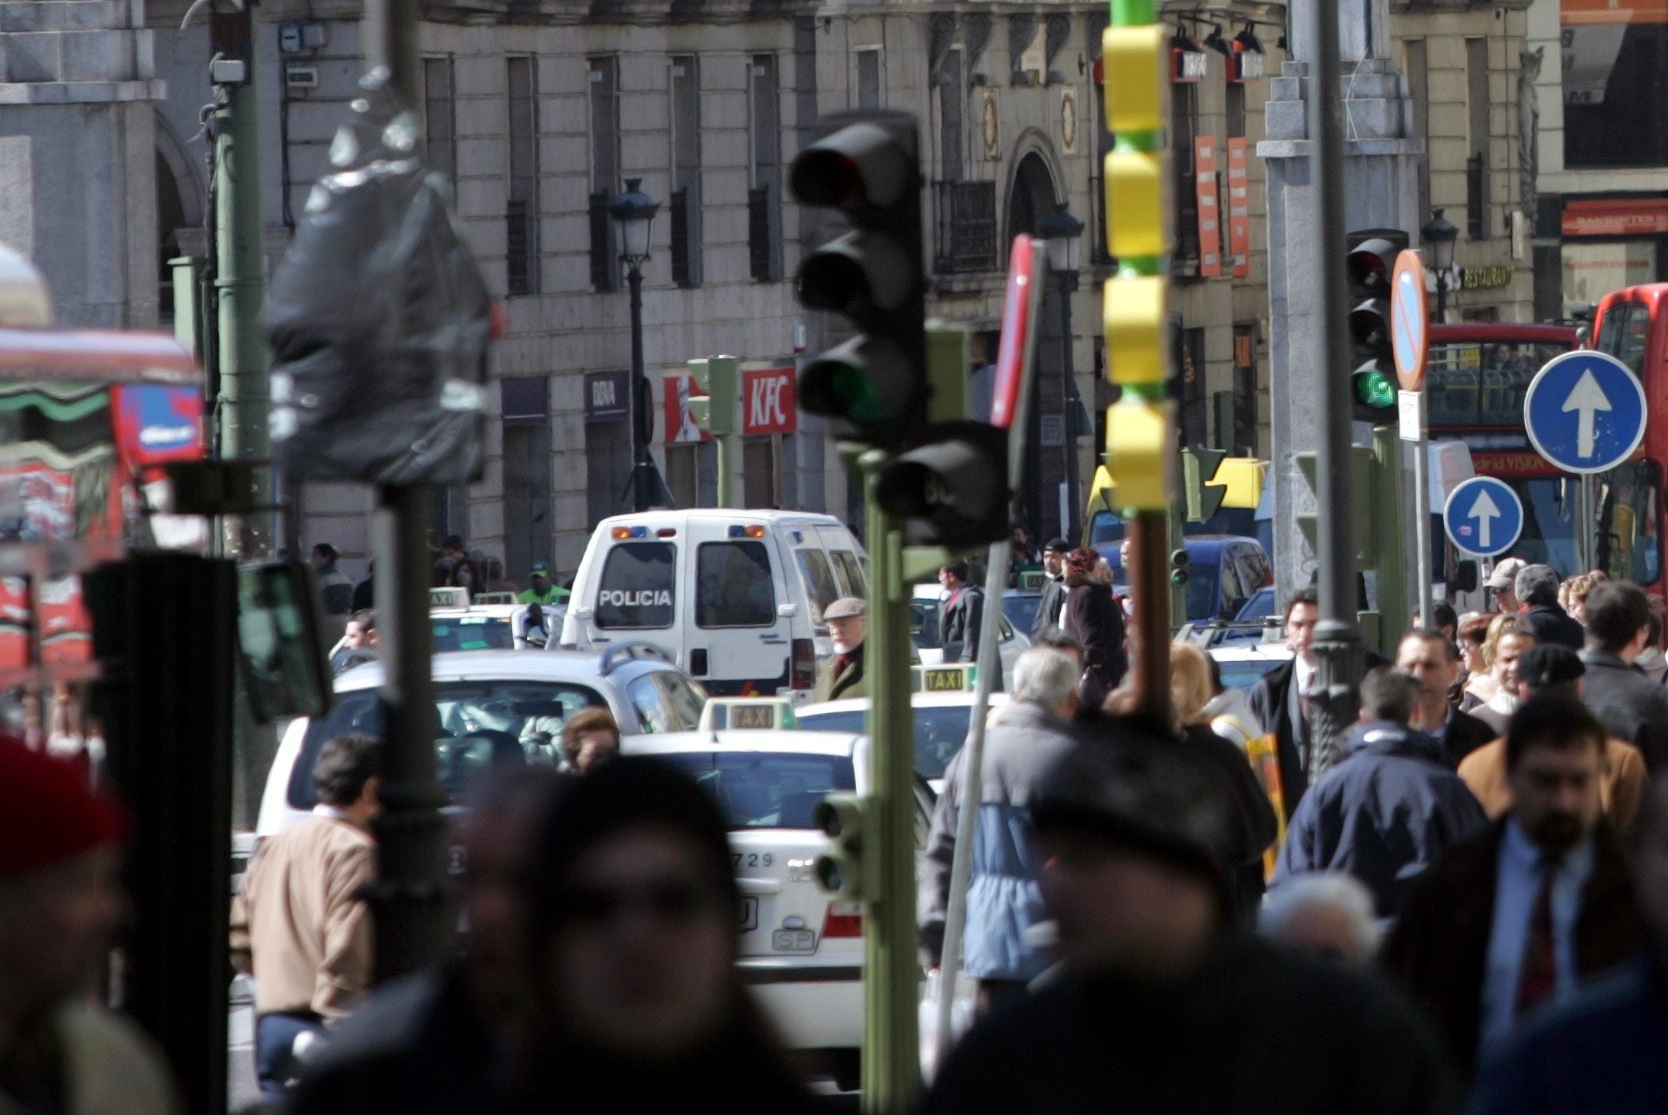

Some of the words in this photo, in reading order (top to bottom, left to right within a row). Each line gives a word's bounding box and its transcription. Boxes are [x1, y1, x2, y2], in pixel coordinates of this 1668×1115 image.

[592, 380, 616, 407] BBVA
[750, 375, 790, 427] KFC
[431, 593, 453, 604] AXI
[599, 589, 672, 607] POLICIA
[927, 671, 962, 689] TAXI
[733, 707, 773, 727] TAXI
[779, 934, 811, 948] SP
